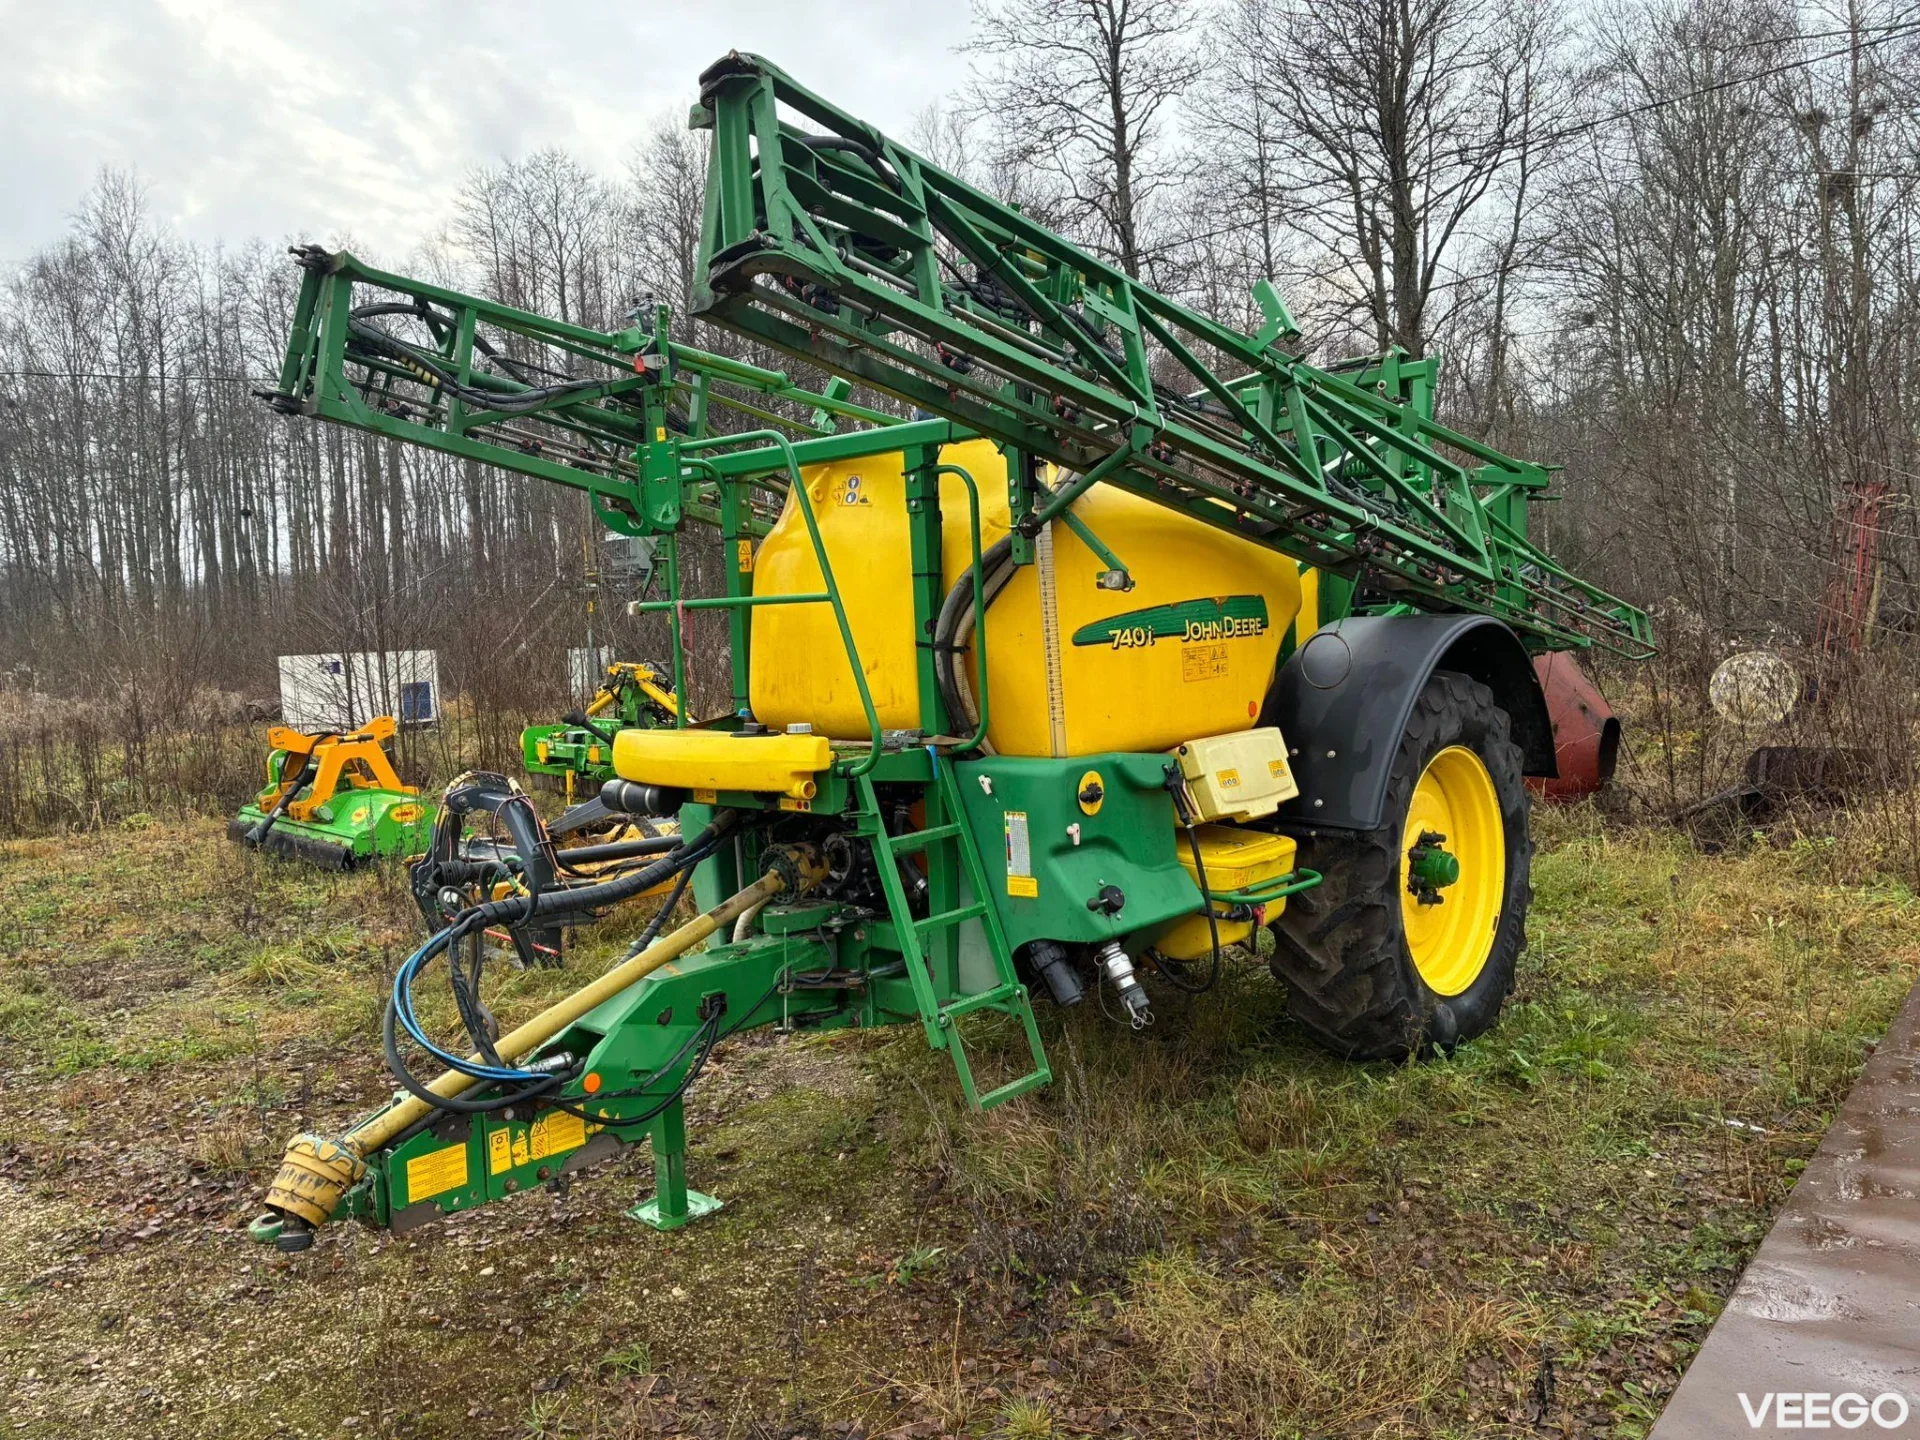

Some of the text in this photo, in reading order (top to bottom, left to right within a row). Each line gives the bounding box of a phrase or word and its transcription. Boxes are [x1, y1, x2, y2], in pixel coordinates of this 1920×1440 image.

[1108, 625, 1155, 649] 740i
[1181, 616, 1263, 642] JOHN DEERE
